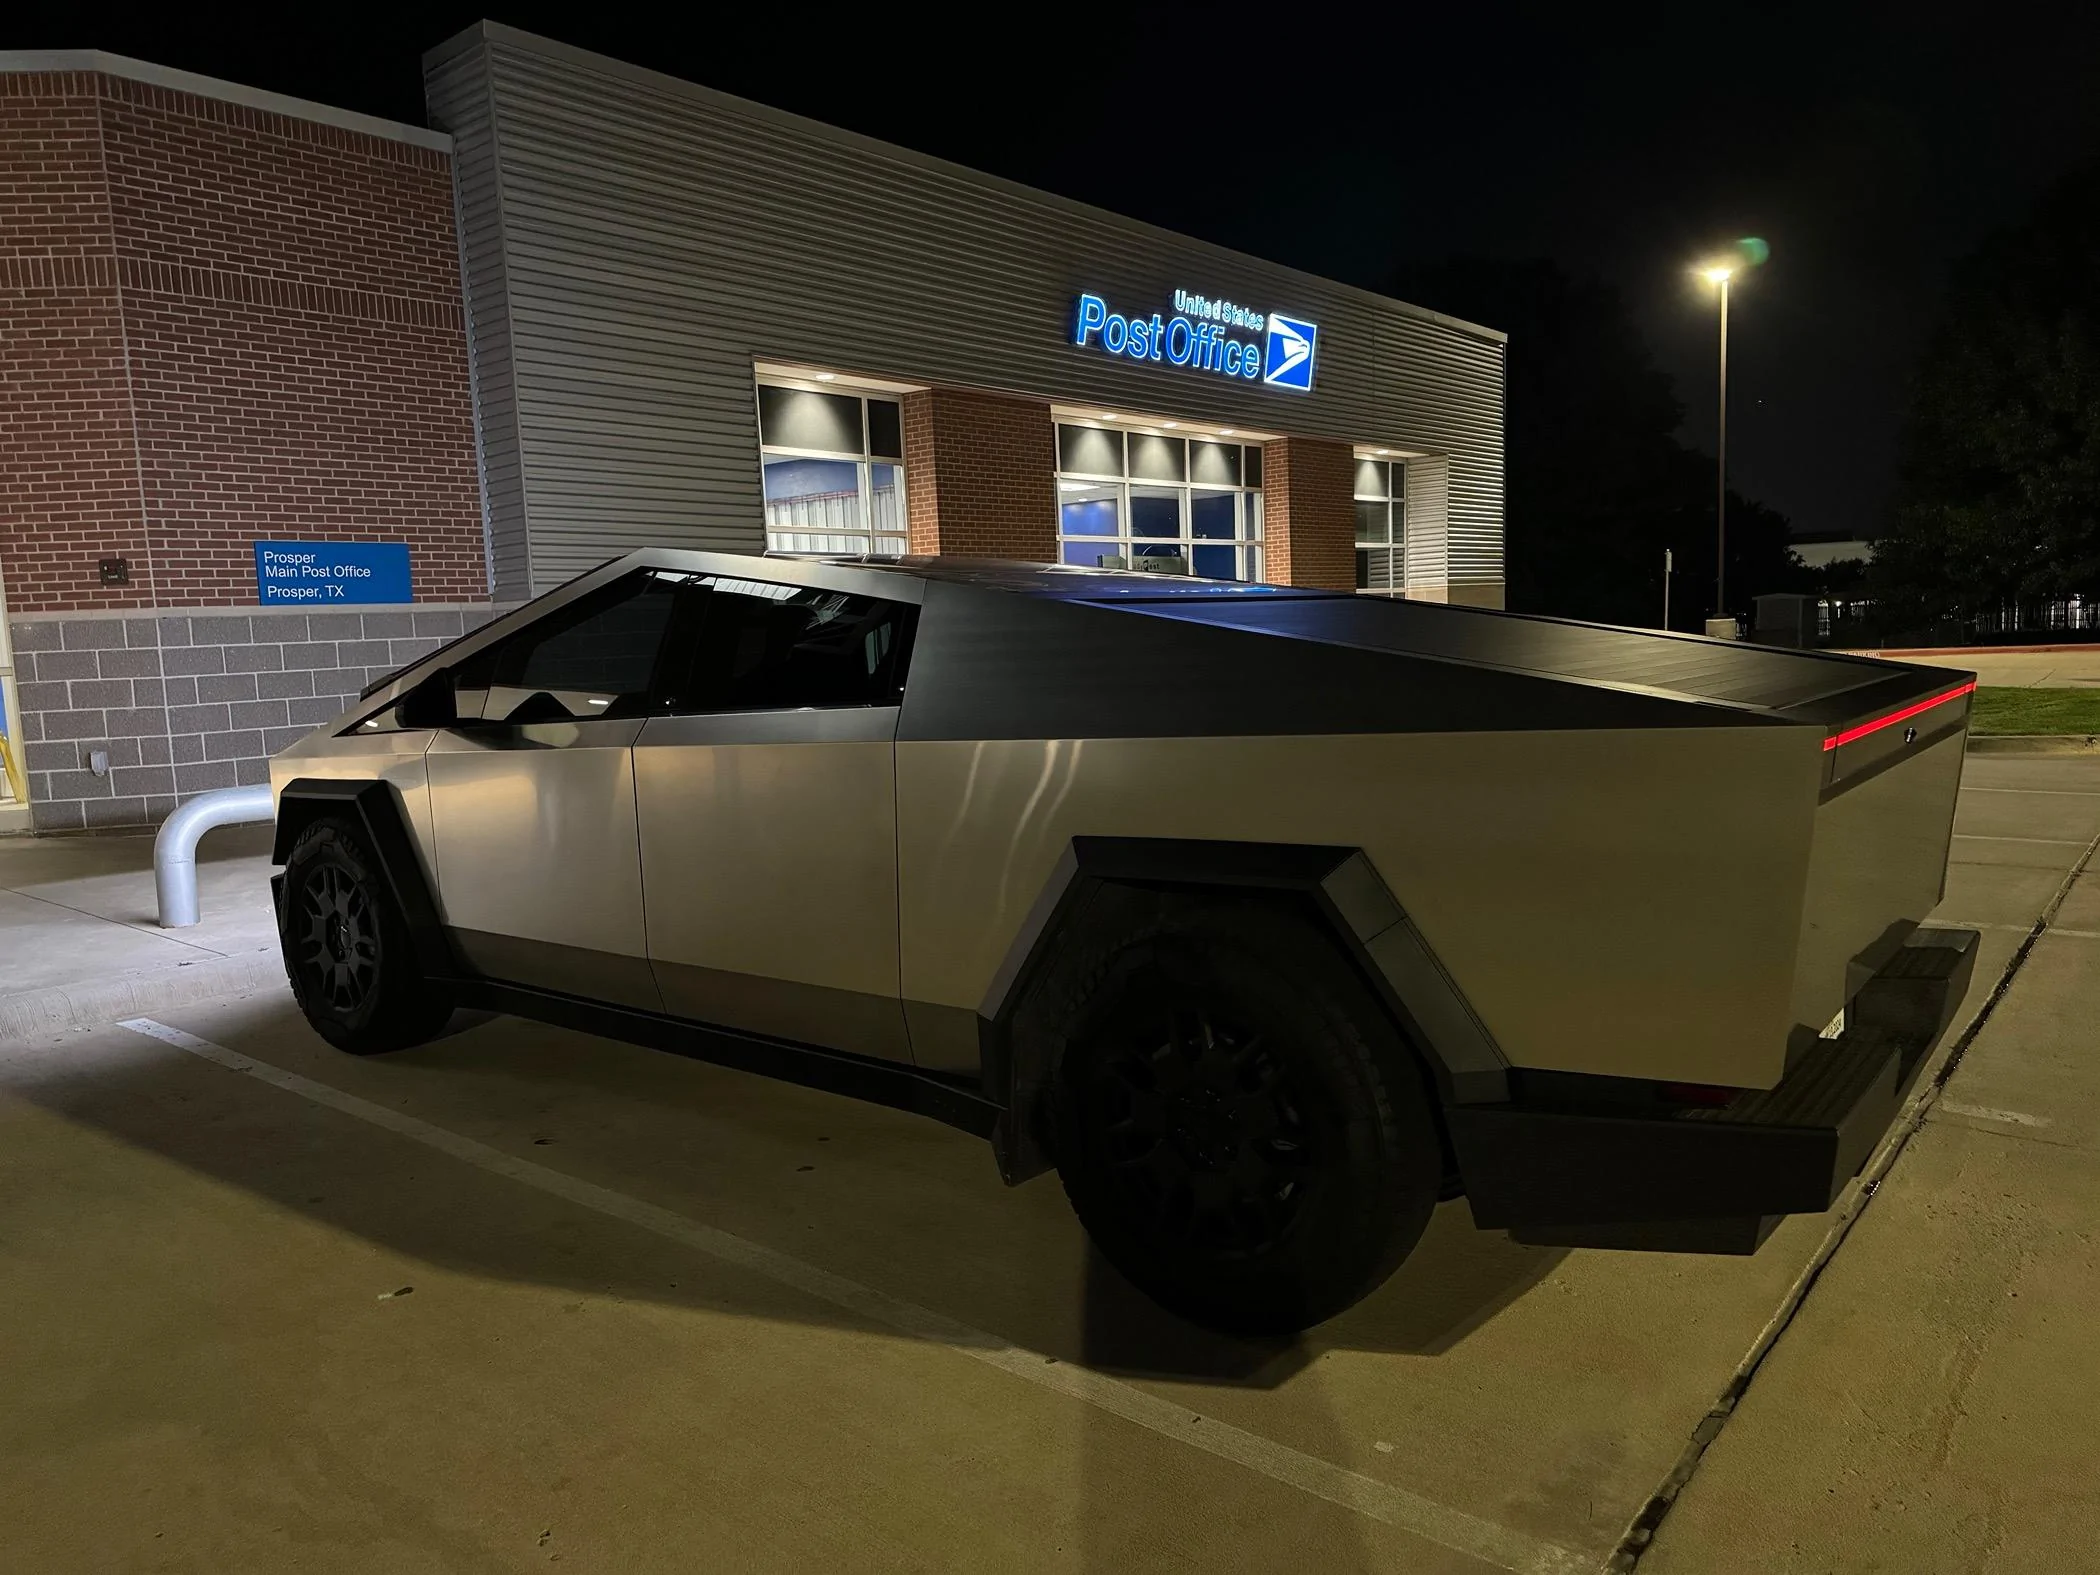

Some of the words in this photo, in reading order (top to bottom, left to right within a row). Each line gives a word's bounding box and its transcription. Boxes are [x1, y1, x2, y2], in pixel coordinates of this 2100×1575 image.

[1174, 288, 1221, 319] United
[1222, 301, 1264, 331] States
[1076, 293, 1163, 361] Post
[1165, 315, 1260, 378] Office
[263, 551, 316, 566] Prosper
[265, 566, 298, 578] Main
[302, 566, 331, 578] Post
[333, 565, 371, 578] Office
[267, 585, 322, 600] Prosper,
[325, 585, 345, 597] TX
